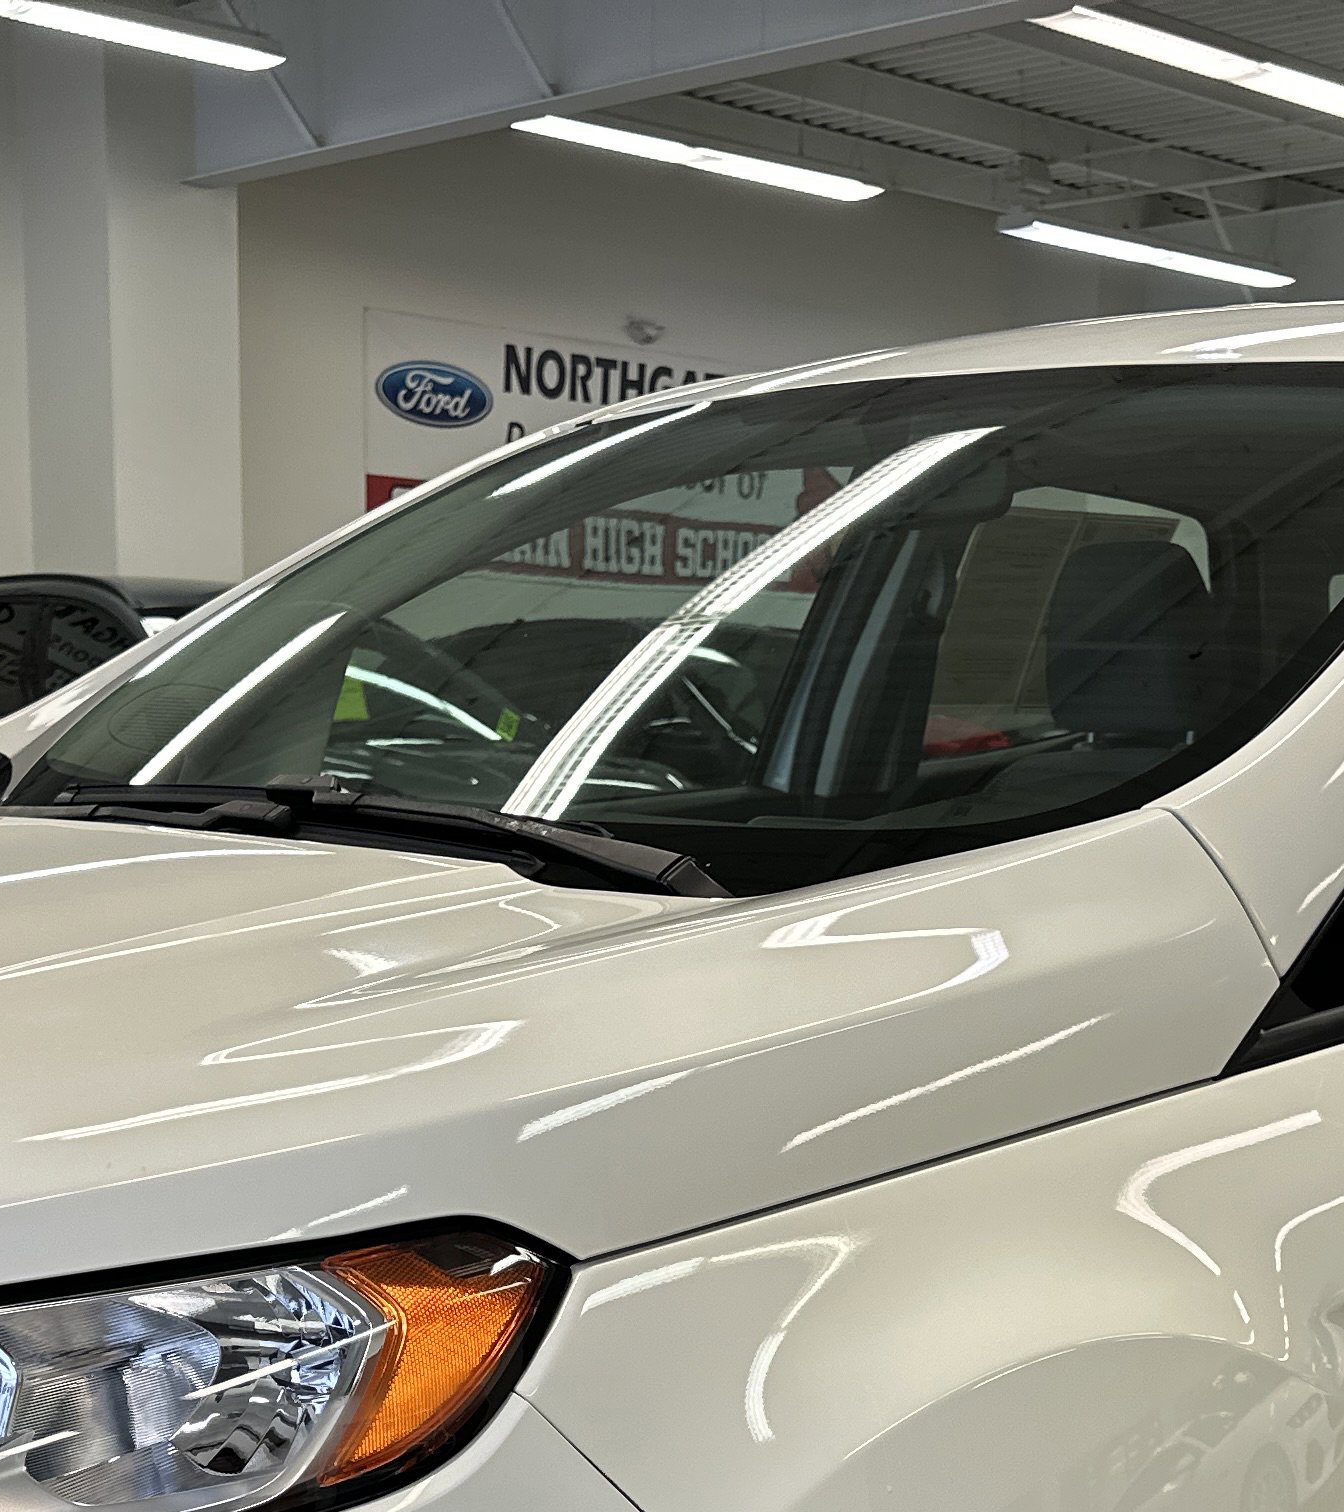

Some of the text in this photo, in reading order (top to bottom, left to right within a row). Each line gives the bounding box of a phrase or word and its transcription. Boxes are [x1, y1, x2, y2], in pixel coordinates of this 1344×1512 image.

[397, 369, 472, 420] Ford
[583, 516, 665, 576] HIGH
[674, 527, 793, 583] SCHO
